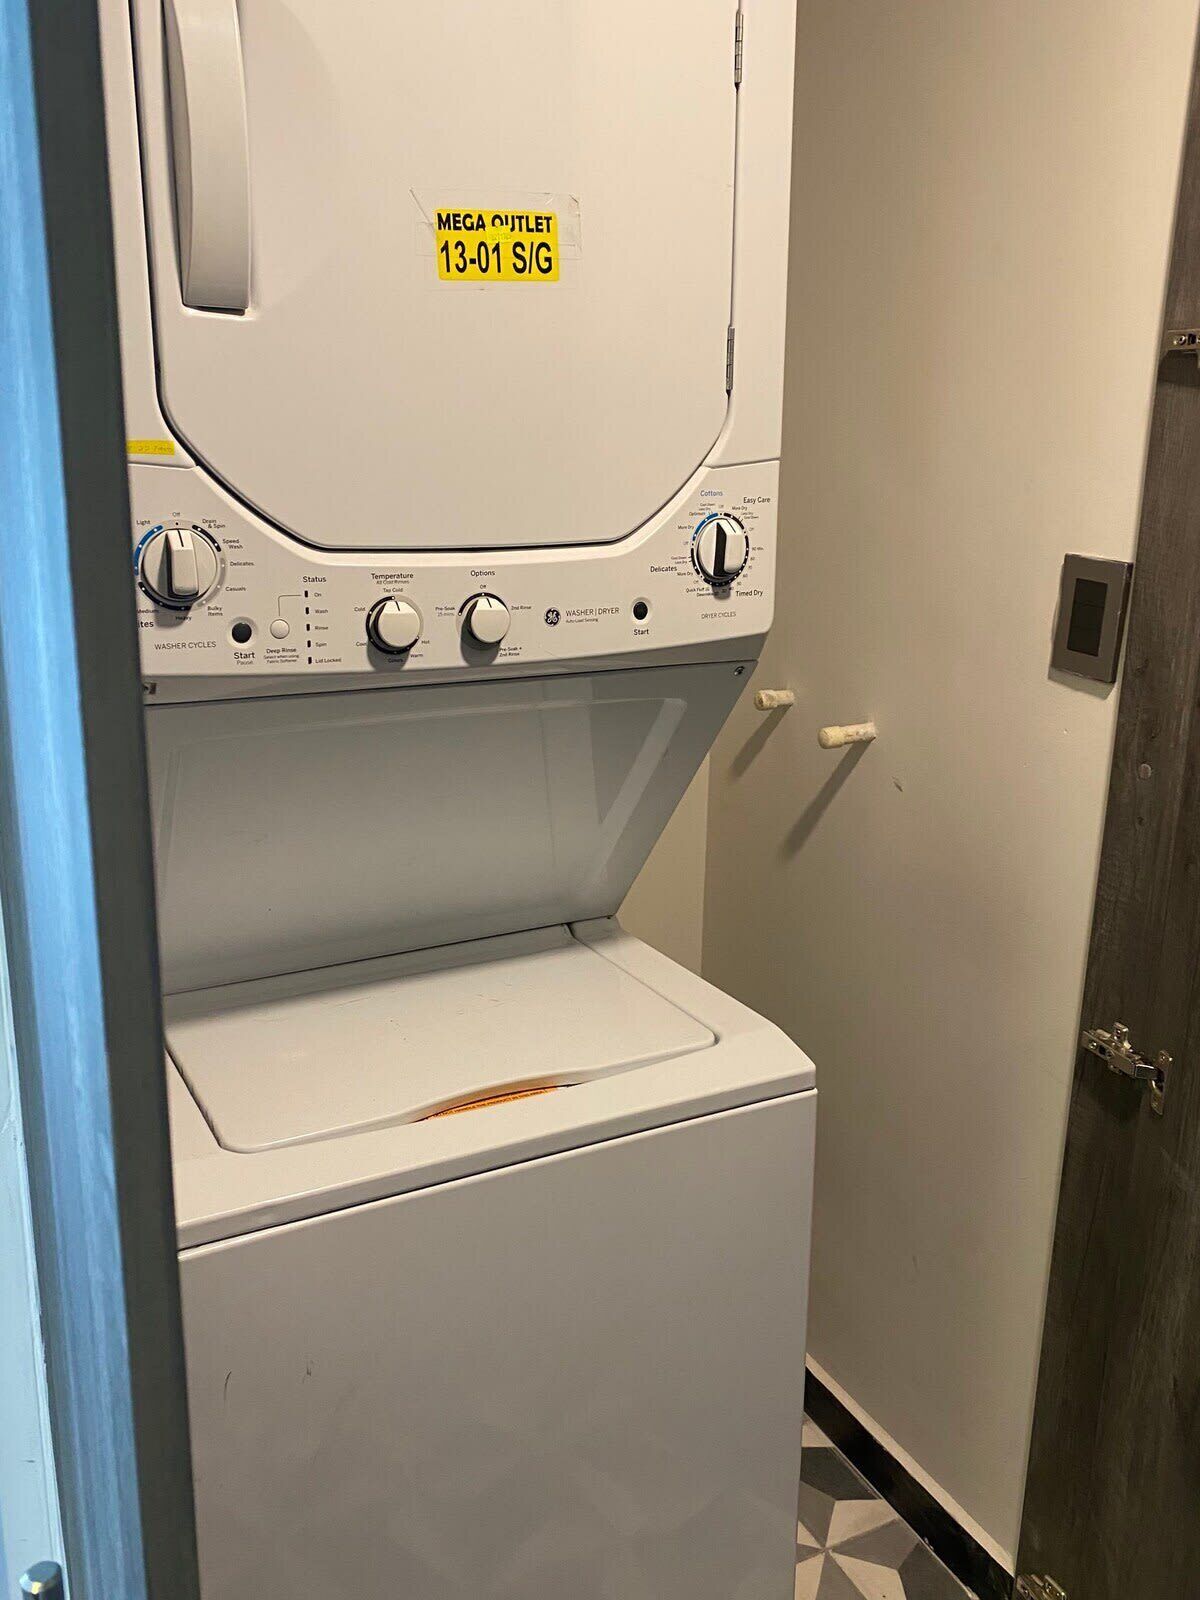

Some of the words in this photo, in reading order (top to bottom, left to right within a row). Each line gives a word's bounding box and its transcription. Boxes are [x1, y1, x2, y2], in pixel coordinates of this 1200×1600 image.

[437, 212, 486, 231] MEGA
[440, 240, 502, 274] 13-01
[512, 241, 553, 275] S/G
[743, 496, 757, 505] Easy
[650, 565, 677, 573] Delicates
[302, 575, 327, 583] Status
[371, 572, 414, 580] Temperature
[753, 589, 763, 597] Dry
[565, 608, 594, 617] WASHER
[597, 607, 620, 615] DRYER
[701, 612, 717, 620] DRYER
[633, 628, 650, 636] Start
[154, 642, 187, 650] WASHER
[187, 641, 217, 649] CYCLES
[233, 651, 256, 660] Start
